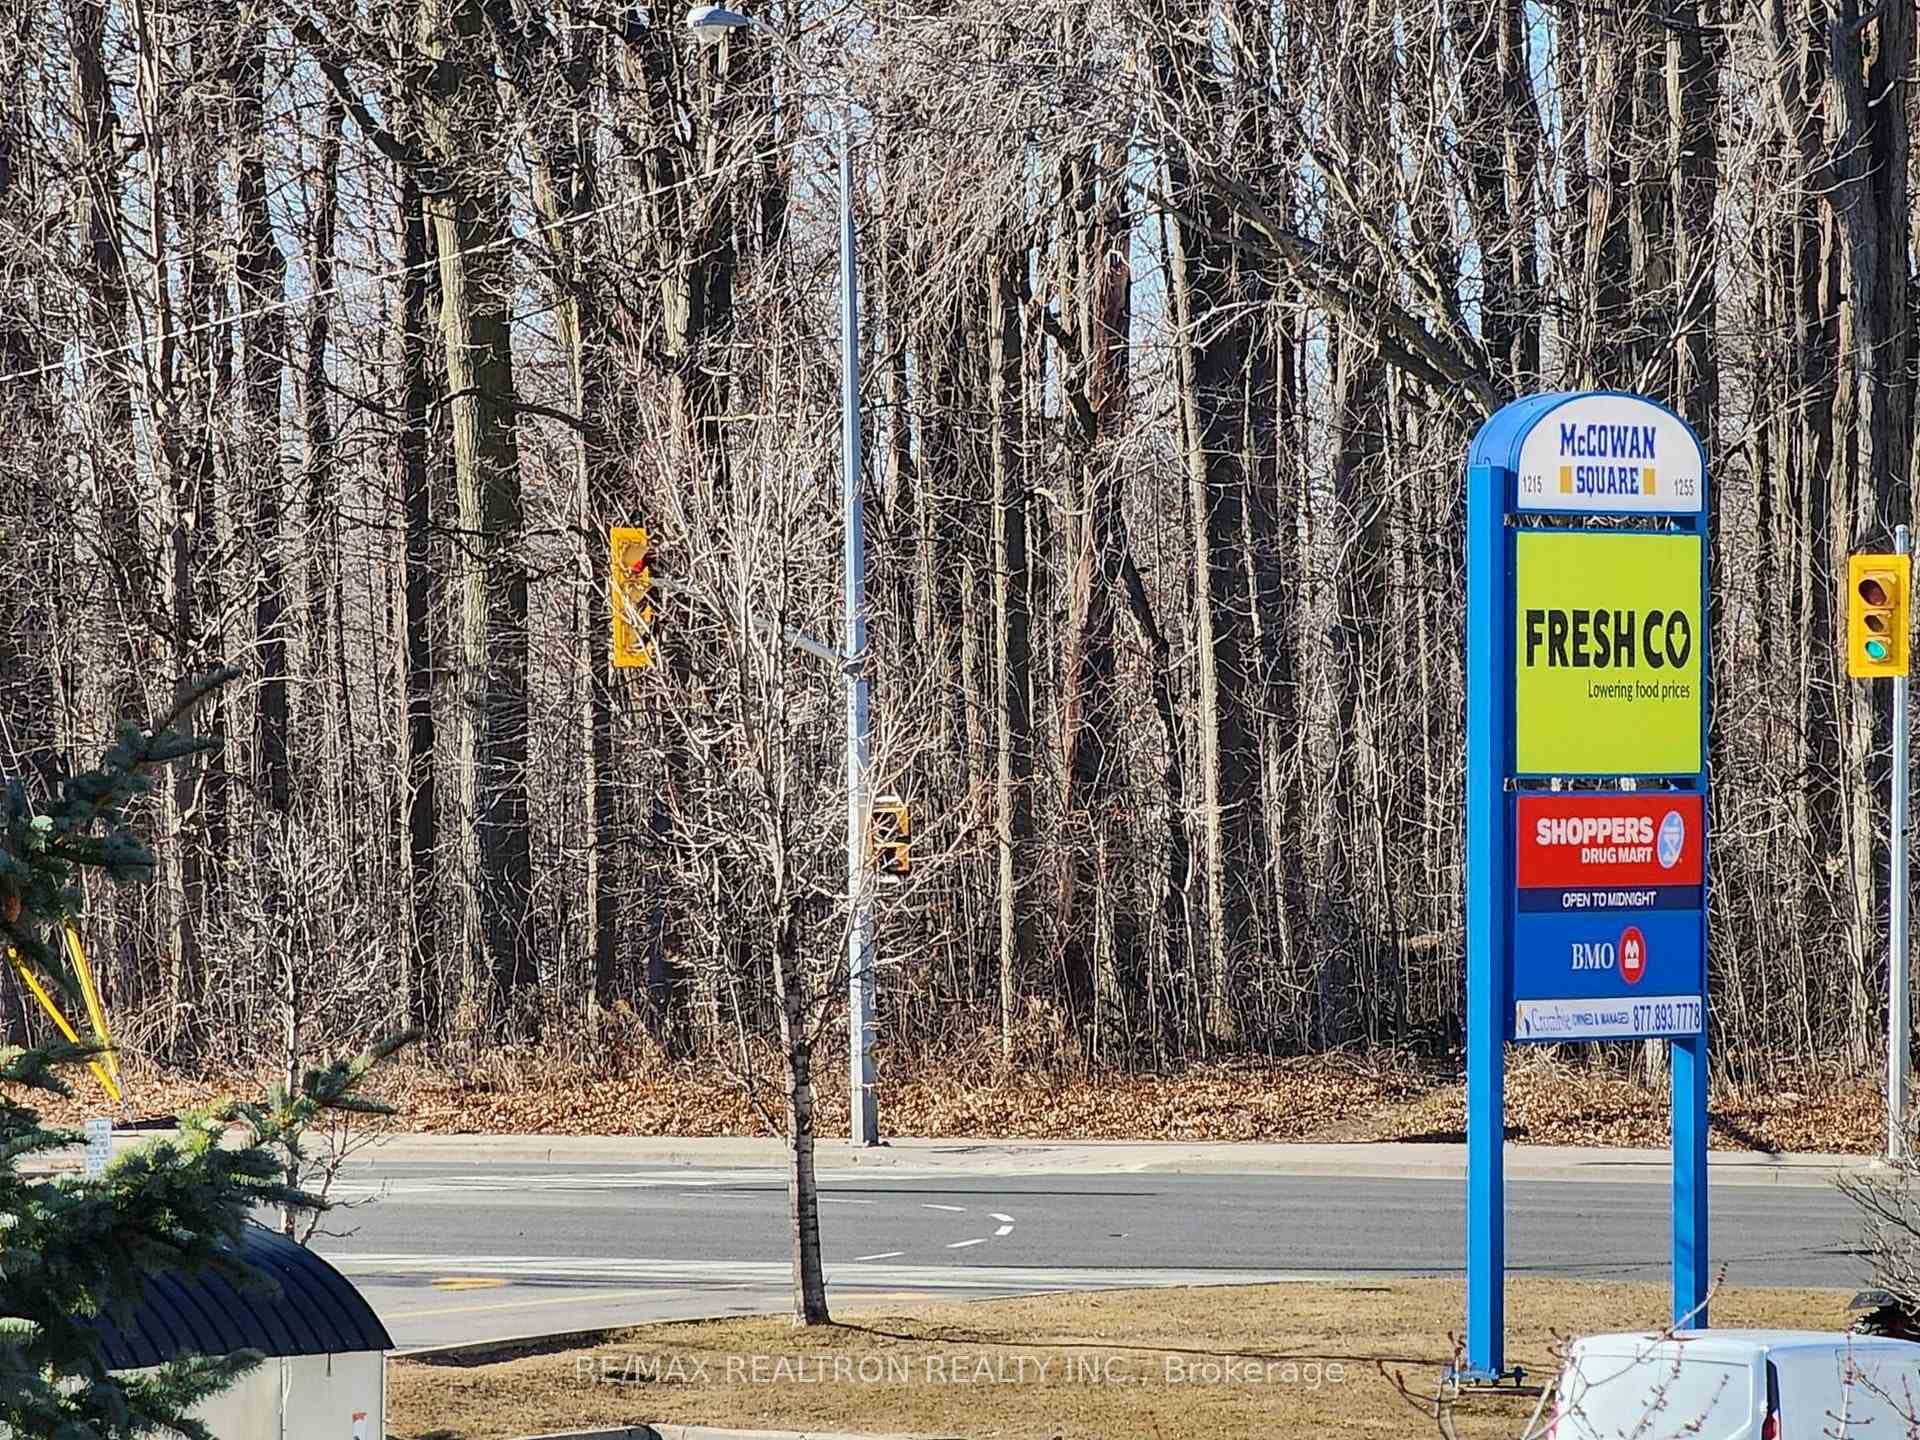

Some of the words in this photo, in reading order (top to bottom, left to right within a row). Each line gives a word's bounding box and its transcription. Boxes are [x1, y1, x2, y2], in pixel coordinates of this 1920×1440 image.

[1560, 423, 1656, 459] McCOWAN
[1522, 474, 1543, 494] 1215
[1576, 466, 1640, 497] SQUARE
[1674, 478, 1695, 497] 1255
[1588, 680, 1633, 702] Lowering
[1635, 680, 1659, 699] food
[1661, 680, 1690, 702] prices
[1536, 816, 1654, 846] SHOPPERS
[1581, 847, 1617, 864] DRUG
[1618, 847, 1653, 863] MART
[1562, 892, 1591, 908] OPEN
[1592, 892, 1607, 907] TO
[1607, 891, 1656, 907] MIDNIGHT
[1571, 942, 1615, 970] BMO
[1633, 1003, 1700, 1032] 877.893.7778
